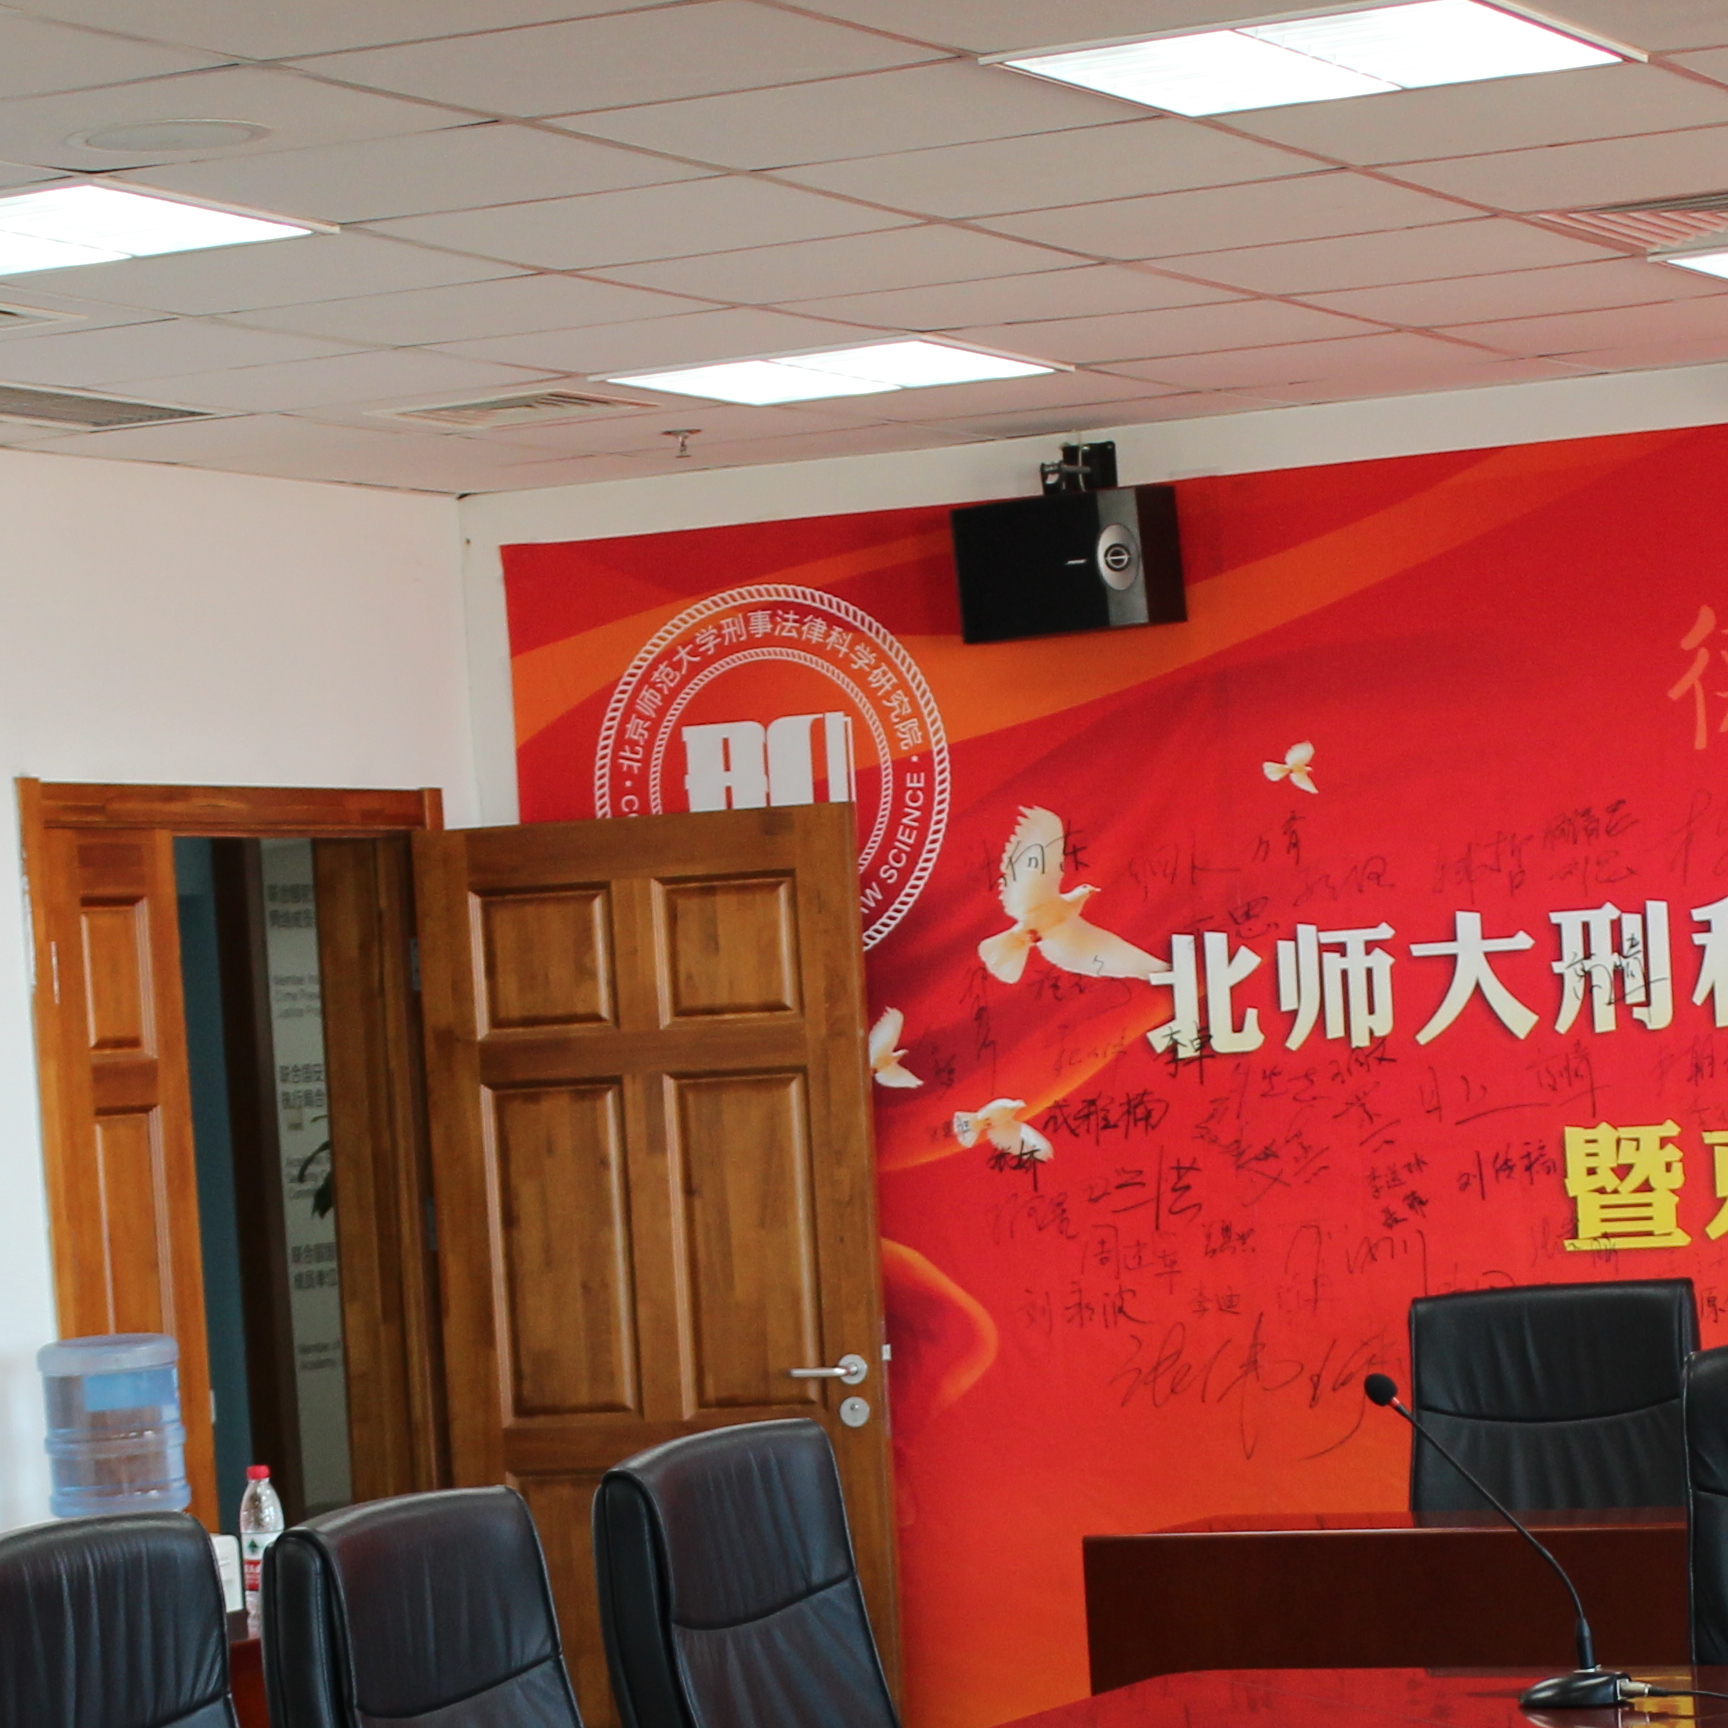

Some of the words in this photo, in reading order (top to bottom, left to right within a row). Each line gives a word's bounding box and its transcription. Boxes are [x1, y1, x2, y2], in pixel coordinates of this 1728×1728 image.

[618, 609, 924, 775] 北京师范大学刑事法律科学研究院
[879, 771, 925, 883] SCIENCE
